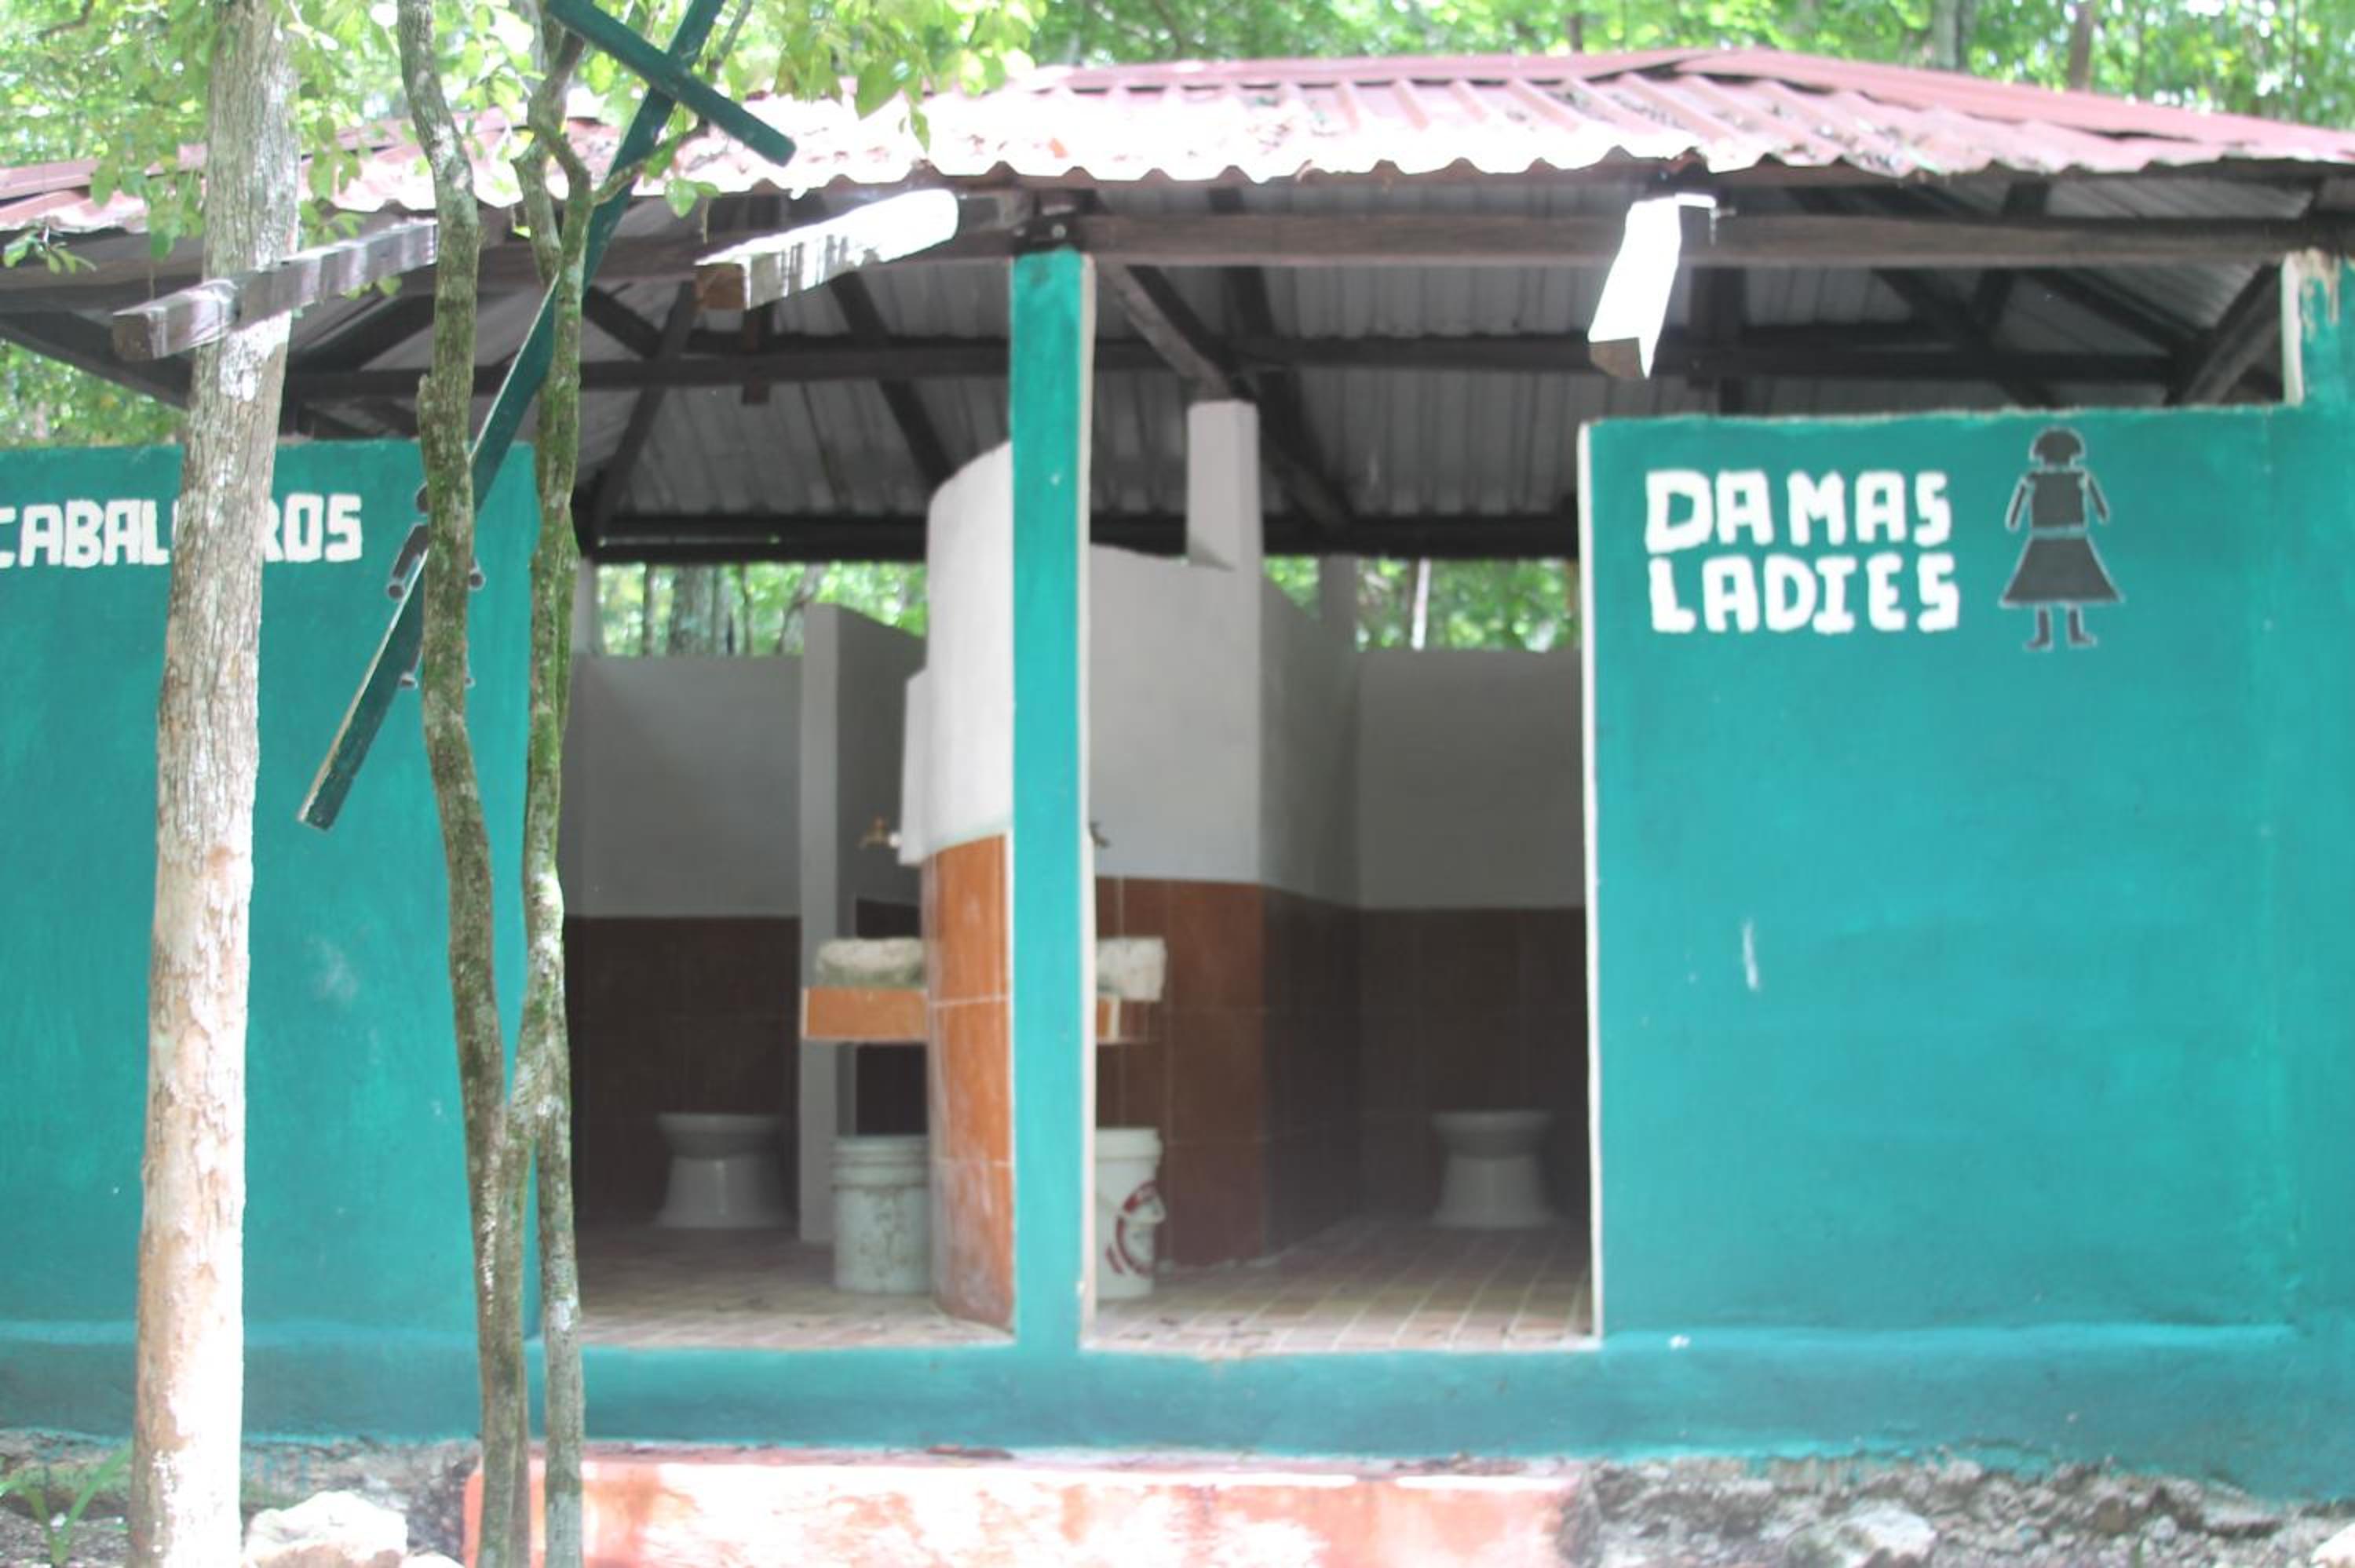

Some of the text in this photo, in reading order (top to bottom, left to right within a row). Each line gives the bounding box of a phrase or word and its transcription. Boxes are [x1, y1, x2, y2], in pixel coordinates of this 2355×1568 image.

[0, 492, 363, 569] ABALOS
[1645, 469, 1952, 553] DAMAS
[1648, 552, 1961, 634] LADIES
